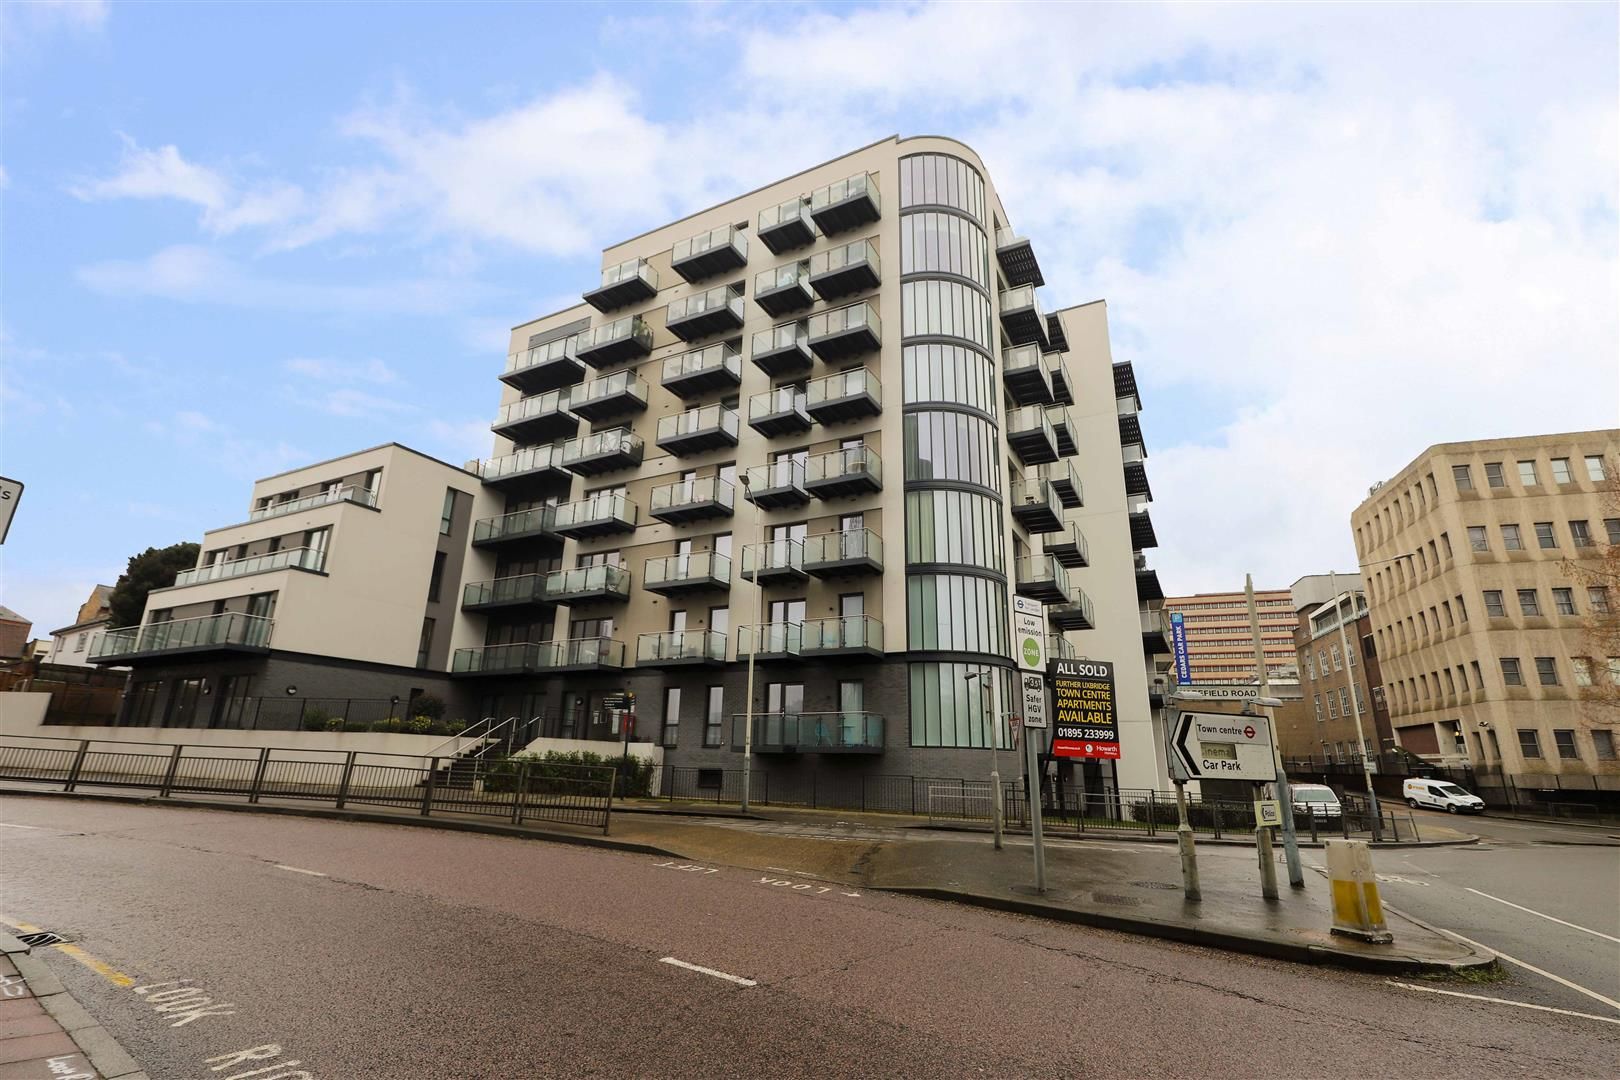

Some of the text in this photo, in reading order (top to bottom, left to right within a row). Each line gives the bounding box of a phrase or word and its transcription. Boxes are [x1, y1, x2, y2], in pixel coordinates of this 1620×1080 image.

[1023, 617, 1036, 627] Low
[1017, 627, 1042, 637] emission
[1175, 625, 1183, 642] PARK
[1023, 648, 1039, 657] ZONE
[1177, 641, 1185, 655] CAR
[1056, 662, 1108, 677] ALL SOLD
[1179, 654, 1187, 679] CEDARS
[1055, 680, 1110, 690] FURTHER UXBRIDGE
[1026, 694, 1042, 704] Safer
[1055, 687, 1111, 700] TOWN CENTRE
[1027, 704, 1042, 714] HGV
[1056, 699, 1112, 711] APARTMENTS
[1028, 716, 1042, 724] zone
[1057, 710, 1112, 724] AVAILABLE
[1058, 727, 1114, 740] 01895 233999
[1196, 724, 1243, 735] Town centre
[1202, 760, 1242, 771] Car Park
[652, 861, 719, 875] LEFT
[752, 876, 832, 895] LOOK
[132, 978, 236, 1028] LOOK
